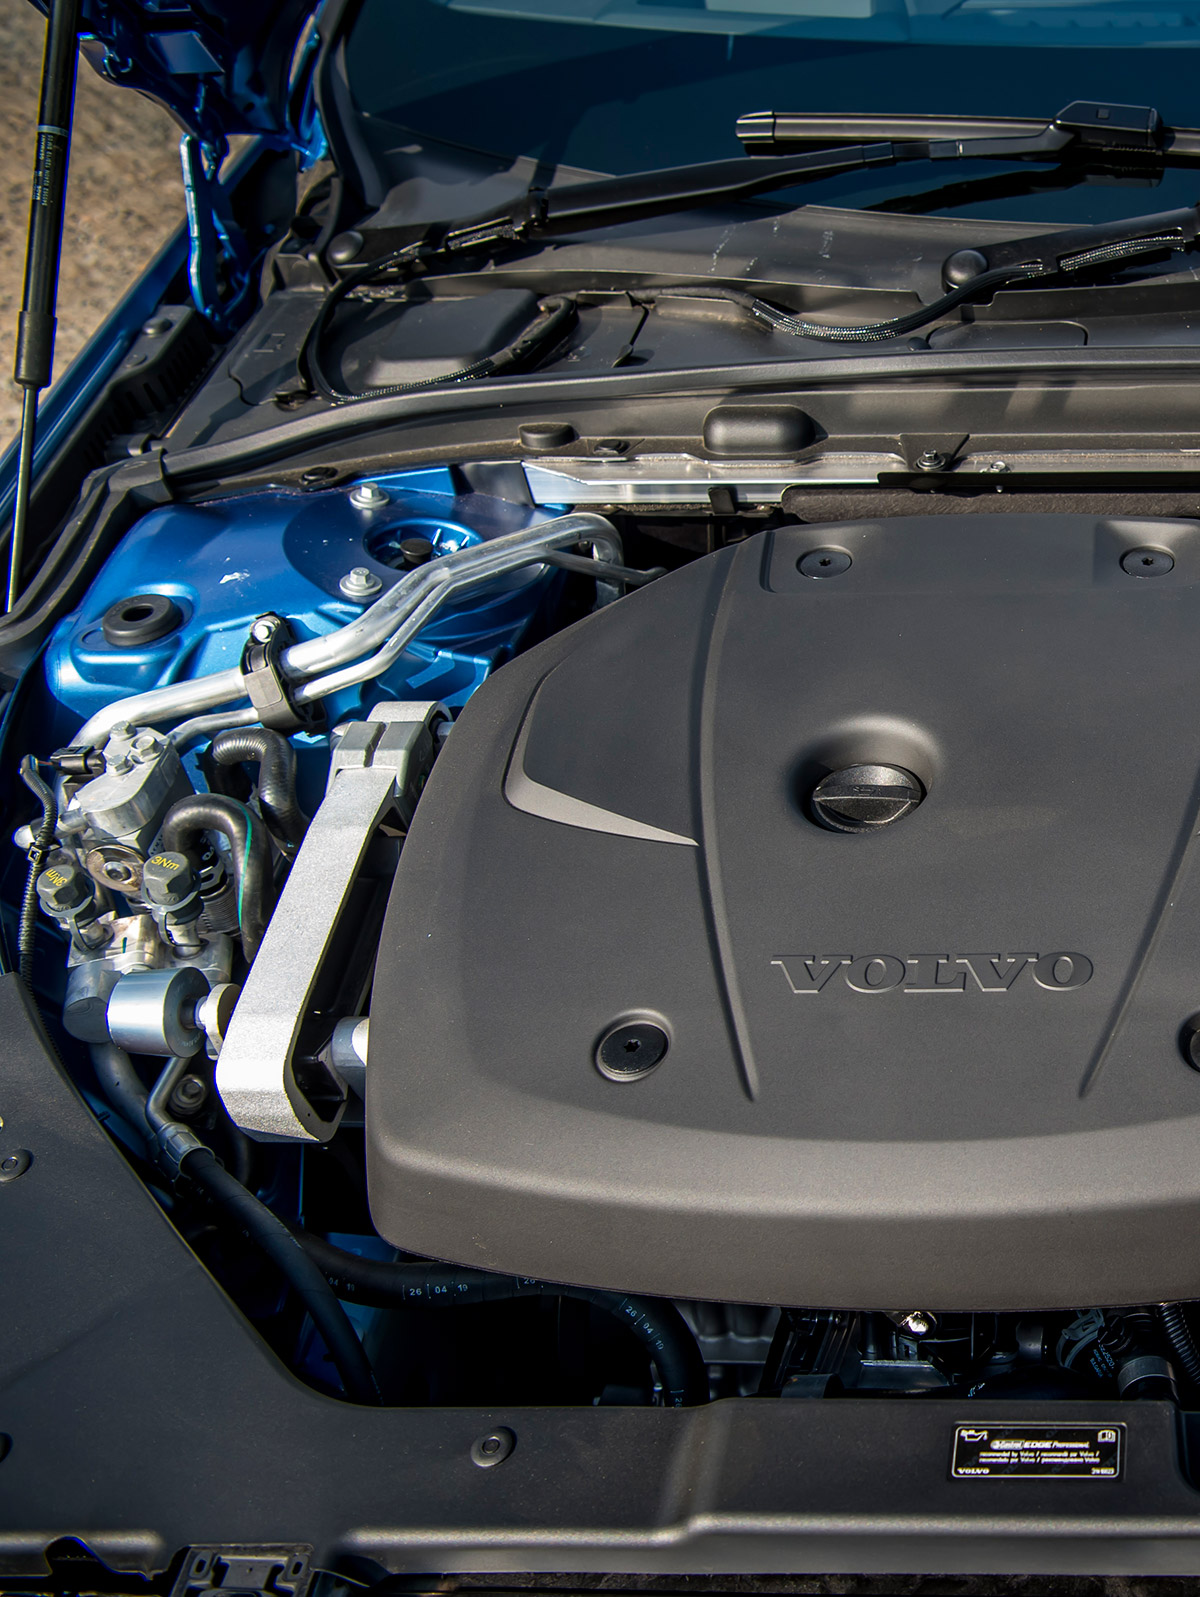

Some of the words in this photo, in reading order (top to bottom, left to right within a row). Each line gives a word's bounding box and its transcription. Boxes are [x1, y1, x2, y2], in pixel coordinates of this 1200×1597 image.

[151, 855, 180, 871] 3Nm
[45, 868, 68, 887] 3Nm
[770, 951, 1094, 995] VOLVO
[409, 1287, 423, 1297] 26
[434, 1285, 448, 1294] 04
[457, 1283, 469, 1293] 19
[625, 1305, 637, 1318] 26
[642, 1322, 654, 1334] 04
[1024, 1441, 1053, 1449] EDGE
